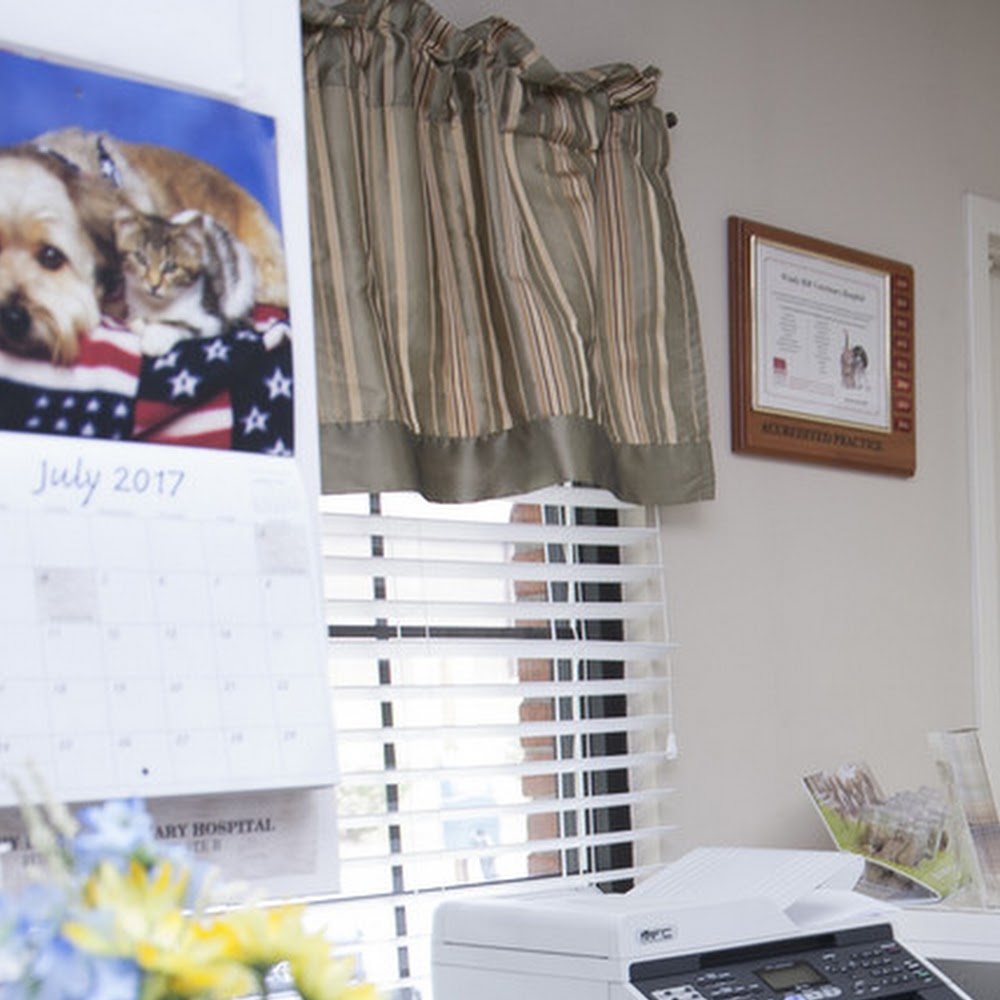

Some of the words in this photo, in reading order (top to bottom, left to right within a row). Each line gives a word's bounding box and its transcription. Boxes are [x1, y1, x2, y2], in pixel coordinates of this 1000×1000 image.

[33, 457, 101, 507] July
[113, 466, 185, 496] 2017
[192, 818, 276, 837] HOSPITAL
